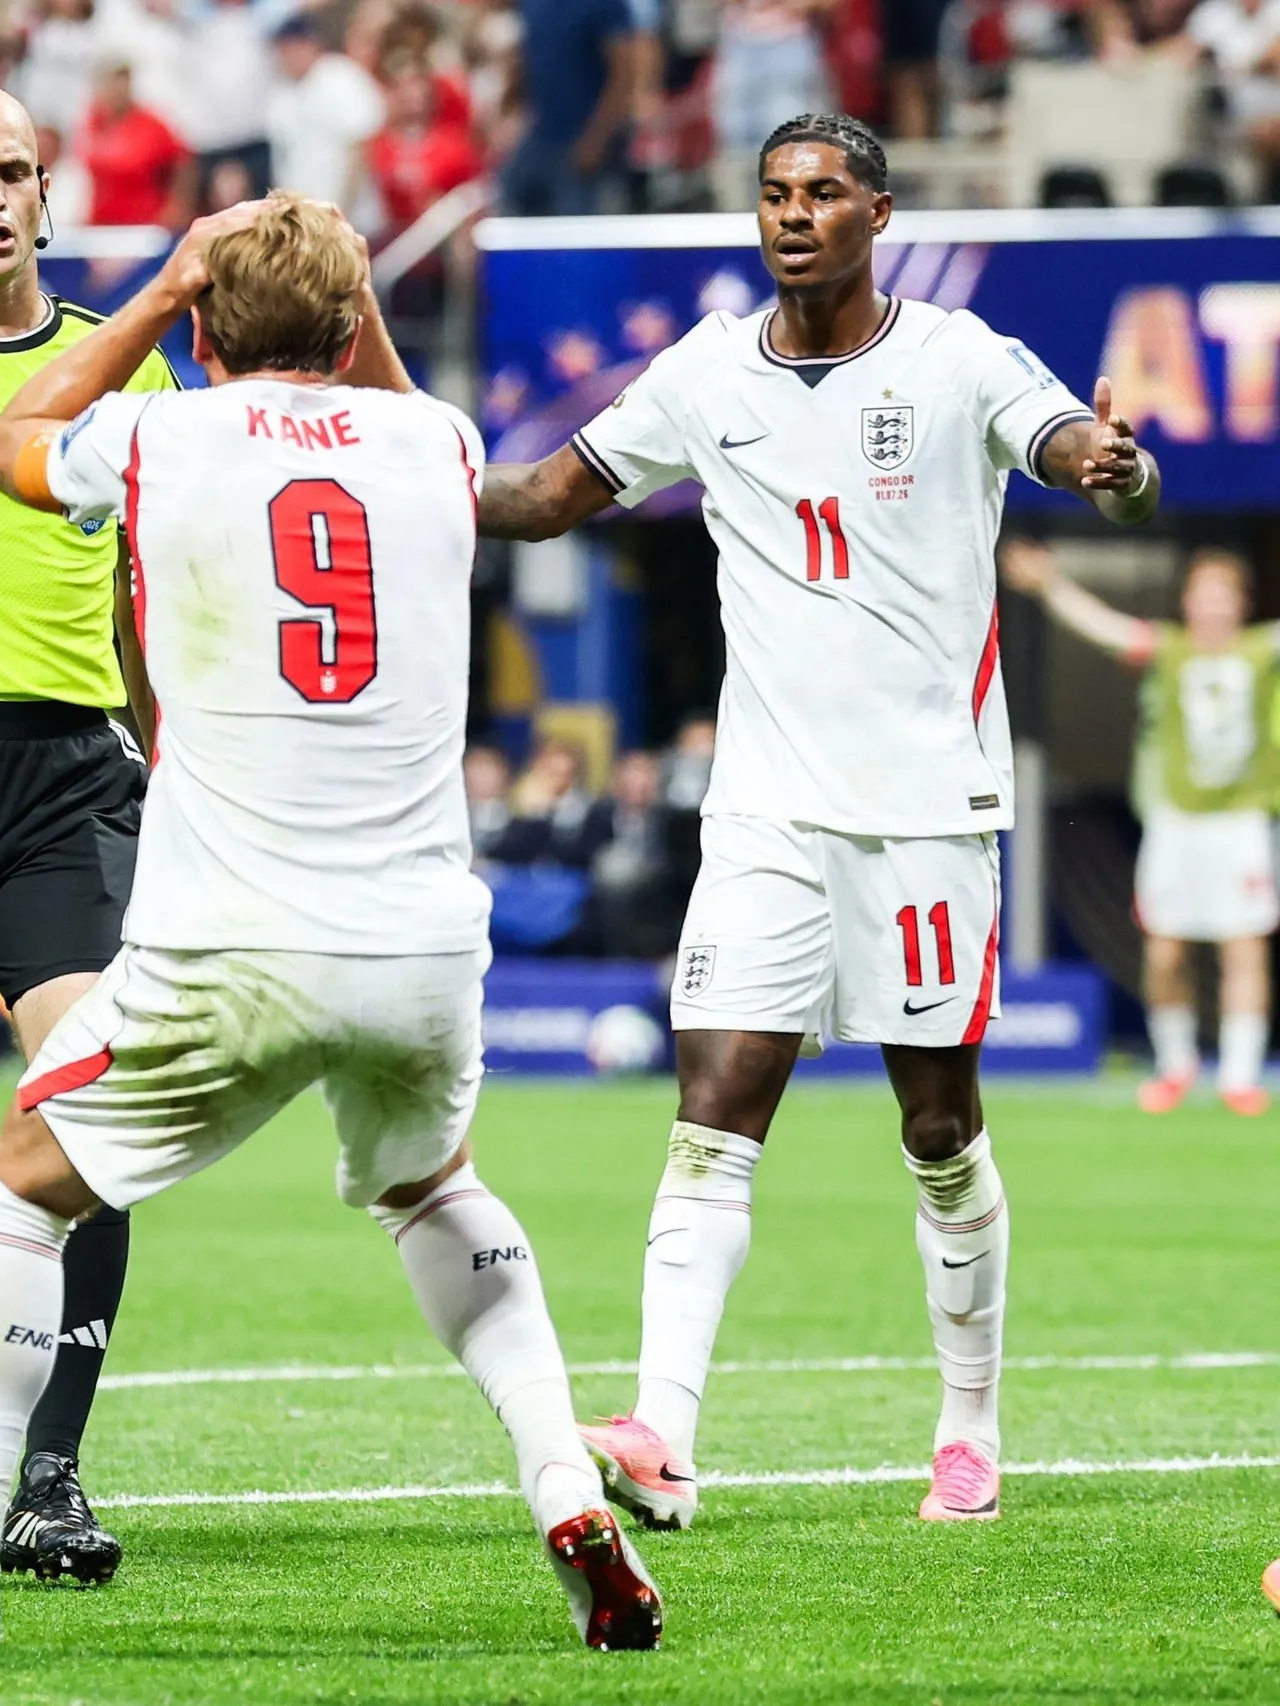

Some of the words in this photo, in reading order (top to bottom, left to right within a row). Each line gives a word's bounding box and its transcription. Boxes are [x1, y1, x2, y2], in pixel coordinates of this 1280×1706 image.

[245, 404, 361, 451] KANE
[868, 476, 899, 487] CONGO
[901, 474, 914, 485] DR
[795, 496, 850, 581] 11
[268, 478, 378, 703] 9
[896, 900, 956, 987] 11
[472, 1246, 527, 1272] ENG
[4, 1324, 54, 1351] ENG
